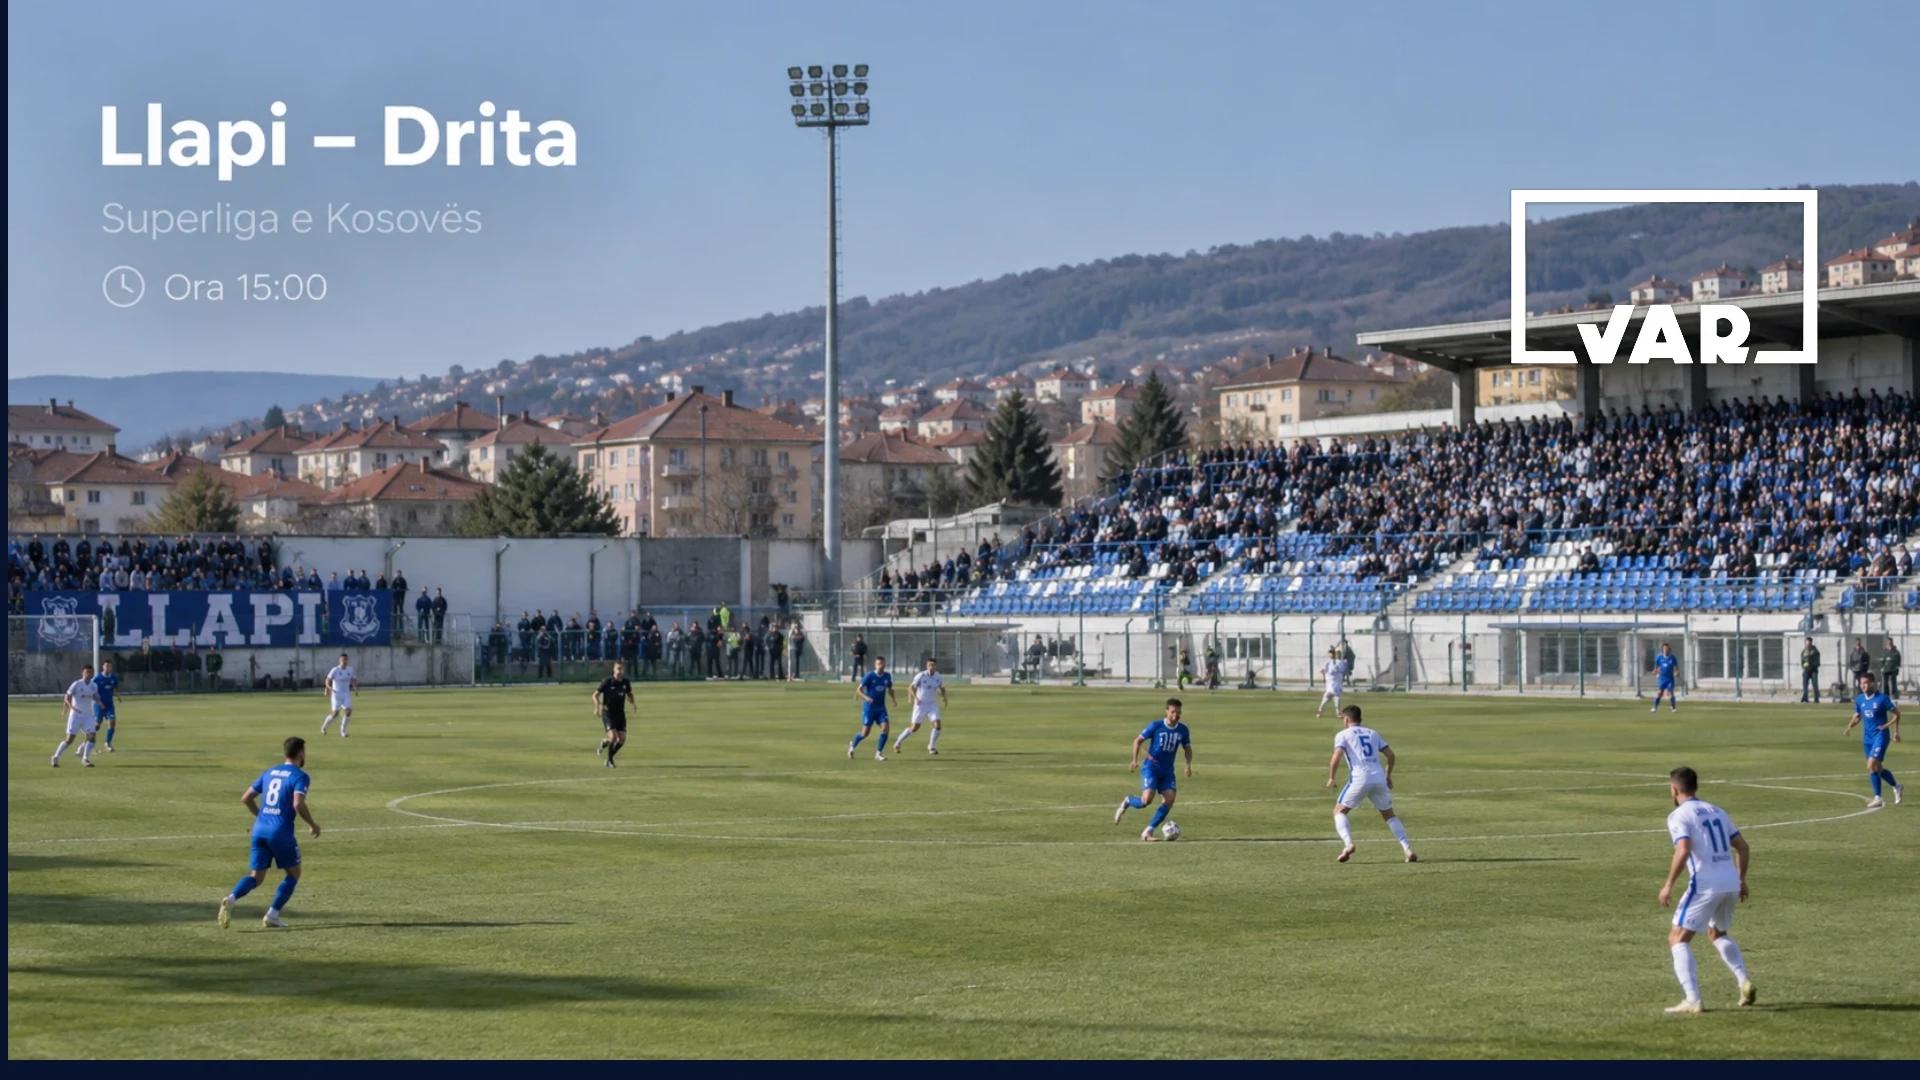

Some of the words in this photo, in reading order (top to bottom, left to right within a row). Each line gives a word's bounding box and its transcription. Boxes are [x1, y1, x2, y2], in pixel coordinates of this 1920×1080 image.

[98, 593, 321, 646] LLAPI
[1359, 735, 1373, 757] 5
[266, 778, 282, 806] 8
[1702, 818, 1728, 852] 11
